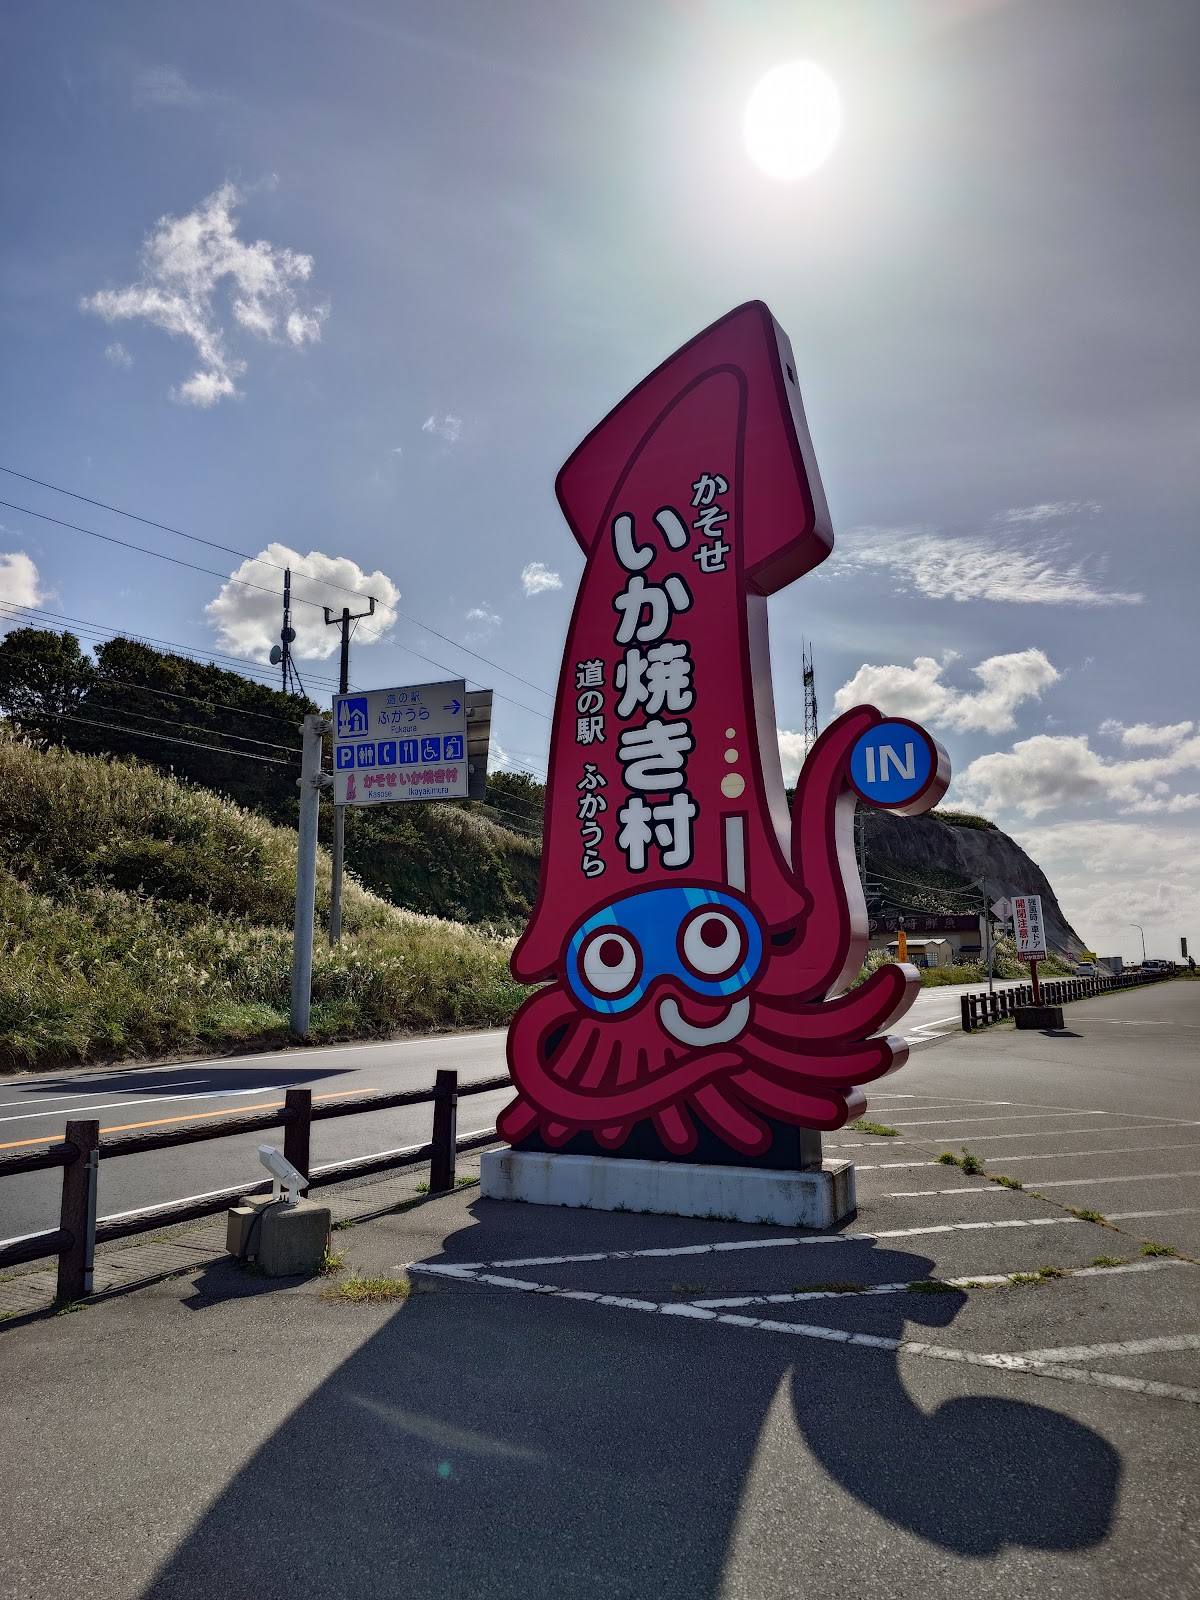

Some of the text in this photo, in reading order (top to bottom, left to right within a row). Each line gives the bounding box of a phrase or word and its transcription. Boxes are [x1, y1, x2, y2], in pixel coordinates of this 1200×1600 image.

[692, 473, 729, 573] かそせ
[386, 690, 421, 705] 道の駅
[576, 660, 605, 745] 道の駅
[613, 508, 696, 870] いか焼き村
[378, 707, 430, 725] ふかうら
[391, 725, 417, 734] Fukaura
[363, 767, 458, 788] かそせ いか焼き村
[865, 742, 915, 783] IN
[368, 787, 449, 798] Kasose Ikayakimura
[577, 763, 607, 878] ふかうら
